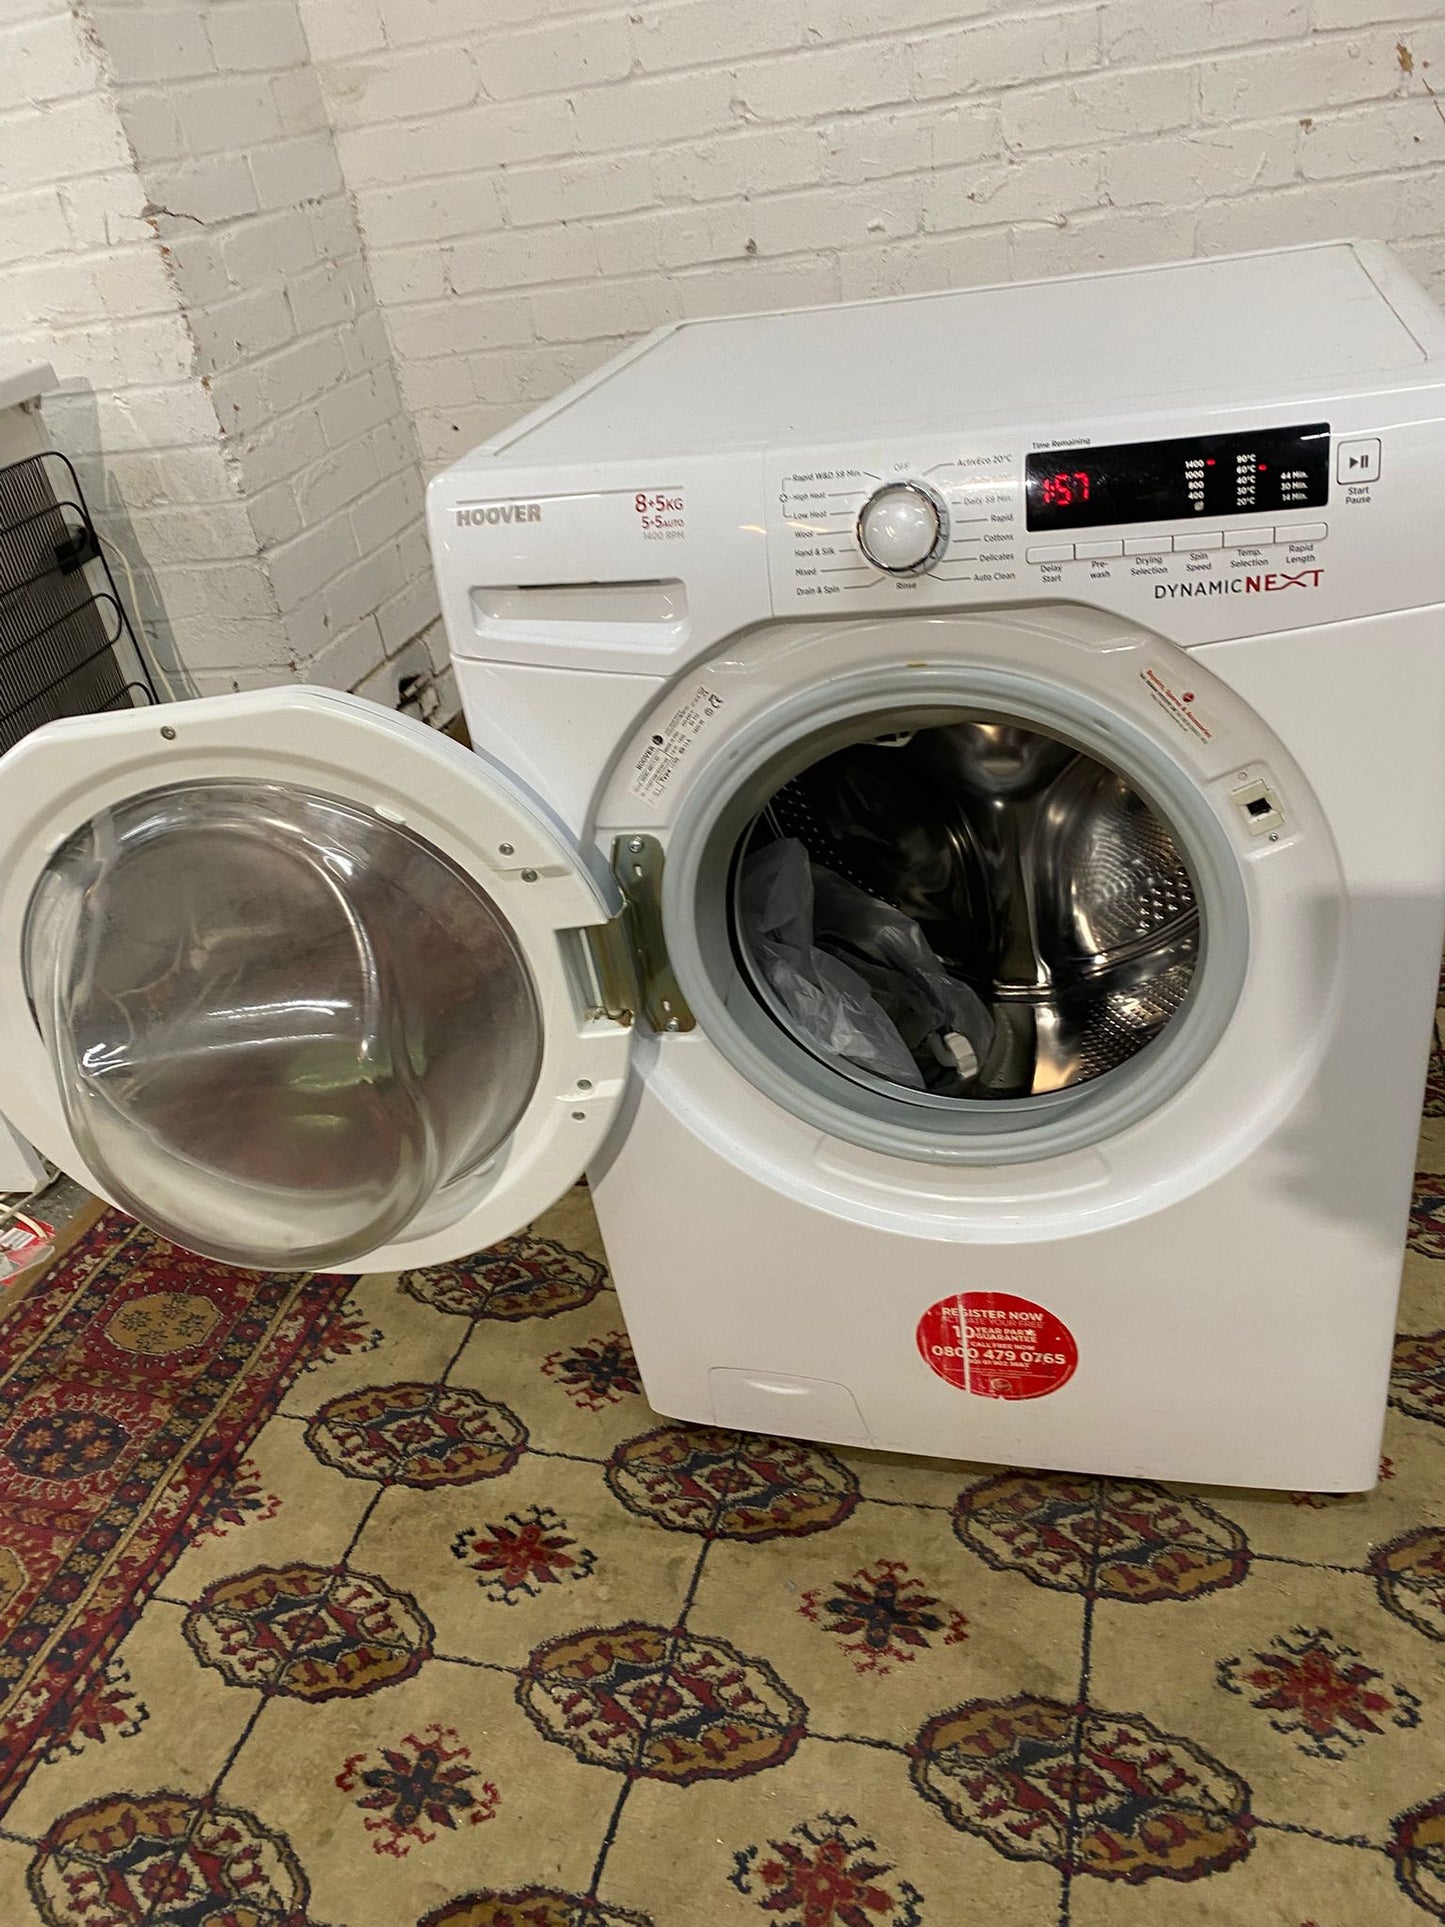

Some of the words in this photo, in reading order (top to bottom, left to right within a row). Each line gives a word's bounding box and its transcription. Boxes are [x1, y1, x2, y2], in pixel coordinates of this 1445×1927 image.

[1032, 441, 1050, 450] Time
[1051, 438, 1091, 448] Remaining
[1185, 459, 1205, 469] 1400
[1184, 469, 1205, 480] 1000
[1236, 464, 1257, 475] 60°C
[792, 472, 814, 482] Rapid
[1280, 471, 1292, 480] 44
[1188, 480, 1205, 490] 800
[809, 491, 826, 499] Heat
[1187, 490, 1205, 500] 400
[1348, 486, 1370, 495] Start
[1345, 496, 1371, 505] Pause
[456, 504, 541, 527] HOOVER
[809, 510, 827, 518] Heat
[990, 513, 1014, 523] Rapid
[794, 530, 813, 539] Wool
[983, 534, 1014, 543] Cottons
[794, 549, 813, 557] Hand
[815, 548, 820, 556] &
[821, 547, 835, 555] Silk
[1288, 543, 1314, 554] Rapid
[979, 553, 1015, 563] Delicates
[1135, 556, 1163, 567] Drying
[1190, 552, 1208, 561] Spin
[1286, 554, 1316, 564] Length
[1186, 562, 1212, 572] Speed
[1229, 558, 1269, 568] Selection
[795, 568, 816, 576] Mixed
[1040, 563, 1062, 574] Delay
[1130, 566, 1168, 576] Selection
[973, 574, 992, 582] Auto
[993, 572, 1016, 581] Clean
[1041, 574, 1062, 583] Start
[1089, 570, 1111, 579] wash
[796, 587, 815, 596] Drain
[816, 586, 822, 594] &
[823, 585, 840, 595] Spin
[896, 581, 917, 590] Rinse
[635, 745, 656, 771] HOOVER
[1008, 1310, 1044, 1322] NOW
[976, 1326, 1001, 1335] YEAR
[976, 1333, 1037, 1343] GUARANTEE
[970, 1341, 991, 1349] CALL
[992, 1342, 1012, 1350] FREE
[931, 1345, 979, 1358] 0800
[983, 1349, 1016, 1361] 479
